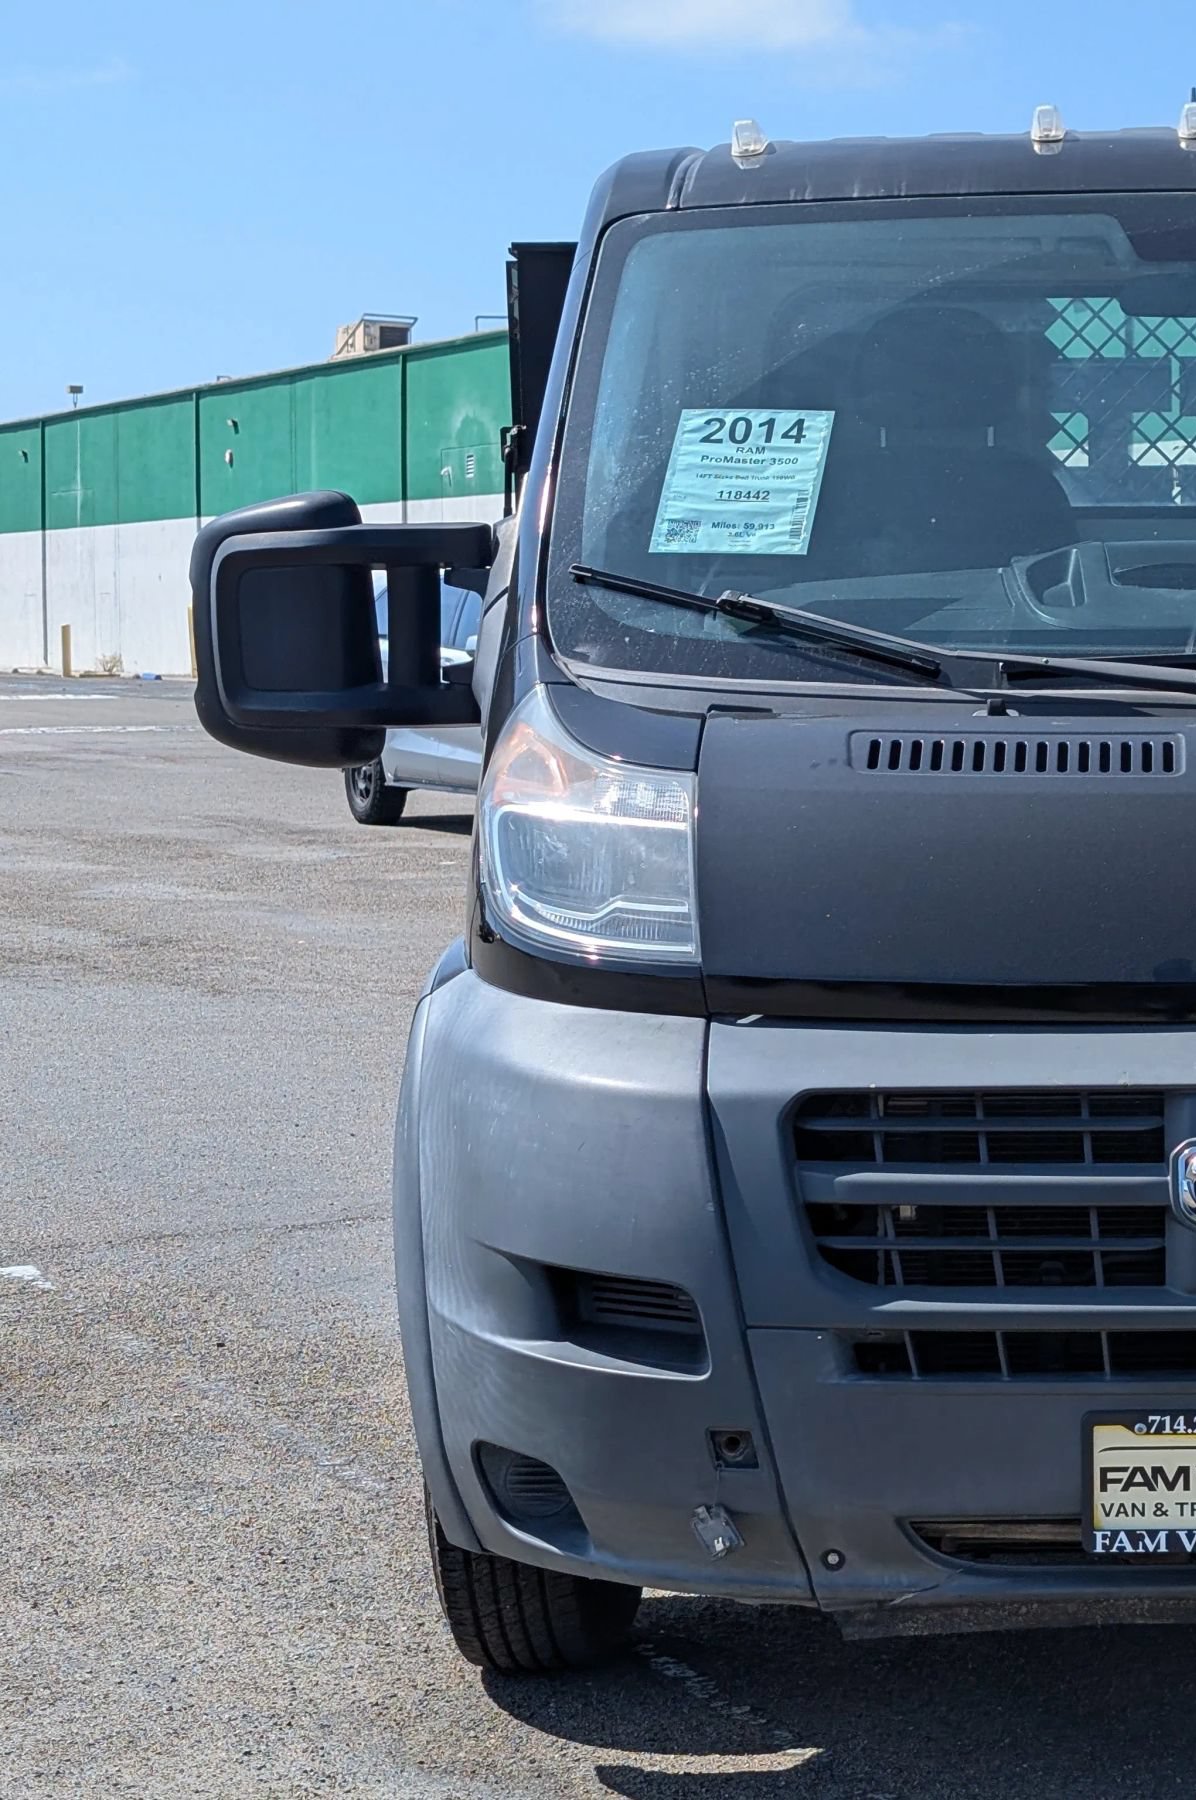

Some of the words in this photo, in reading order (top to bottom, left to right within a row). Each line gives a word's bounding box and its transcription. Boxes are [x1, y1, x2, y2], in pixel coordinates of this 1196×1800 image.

[699, 416, 807, 445] 2014
[736, 446, 766, 454] RAM
[700, 454, 766, 465] ProMaster
[769, 457, 799, 466] 3500
[717, 490, 770, 501] 118442
[1099, 1465, 1191, 1493] FAM
[1100, 1502, 1146, 1518] VAN
[1152, 1502, 1169, 1517] &
[1093, 1530, 1169, 1553] FAM
